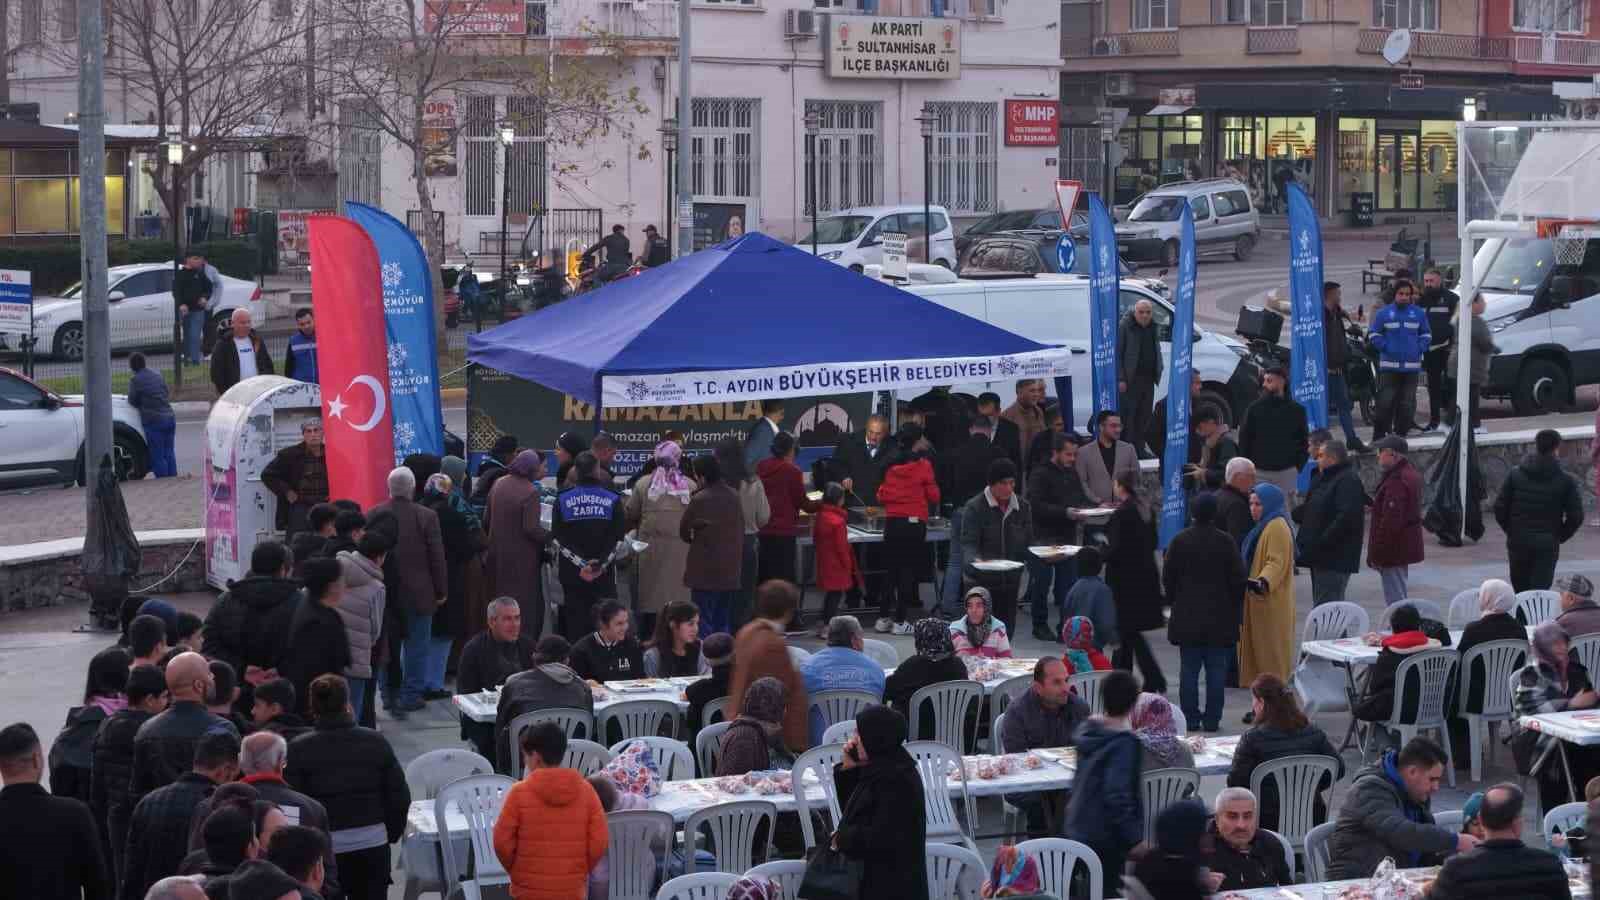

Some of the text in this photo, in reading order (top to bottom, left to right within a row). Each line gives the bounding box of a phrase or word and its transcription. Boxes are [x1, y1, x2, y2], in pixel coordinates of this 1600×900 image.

[871, 20, 923, 37] AK PARTİ
[857, 39, 936, 55] SULTANHİSAR
[842, 56, 949, 75] İLÇE BAŞKANLIĞI
[1025, 105, 1056, 121] MHP
[694, 359, 992, 395] T.C. AYDIN BÜYÜKŞEHİR BELEDİYESİ
[573, 505, 605, 516] ZABITA
